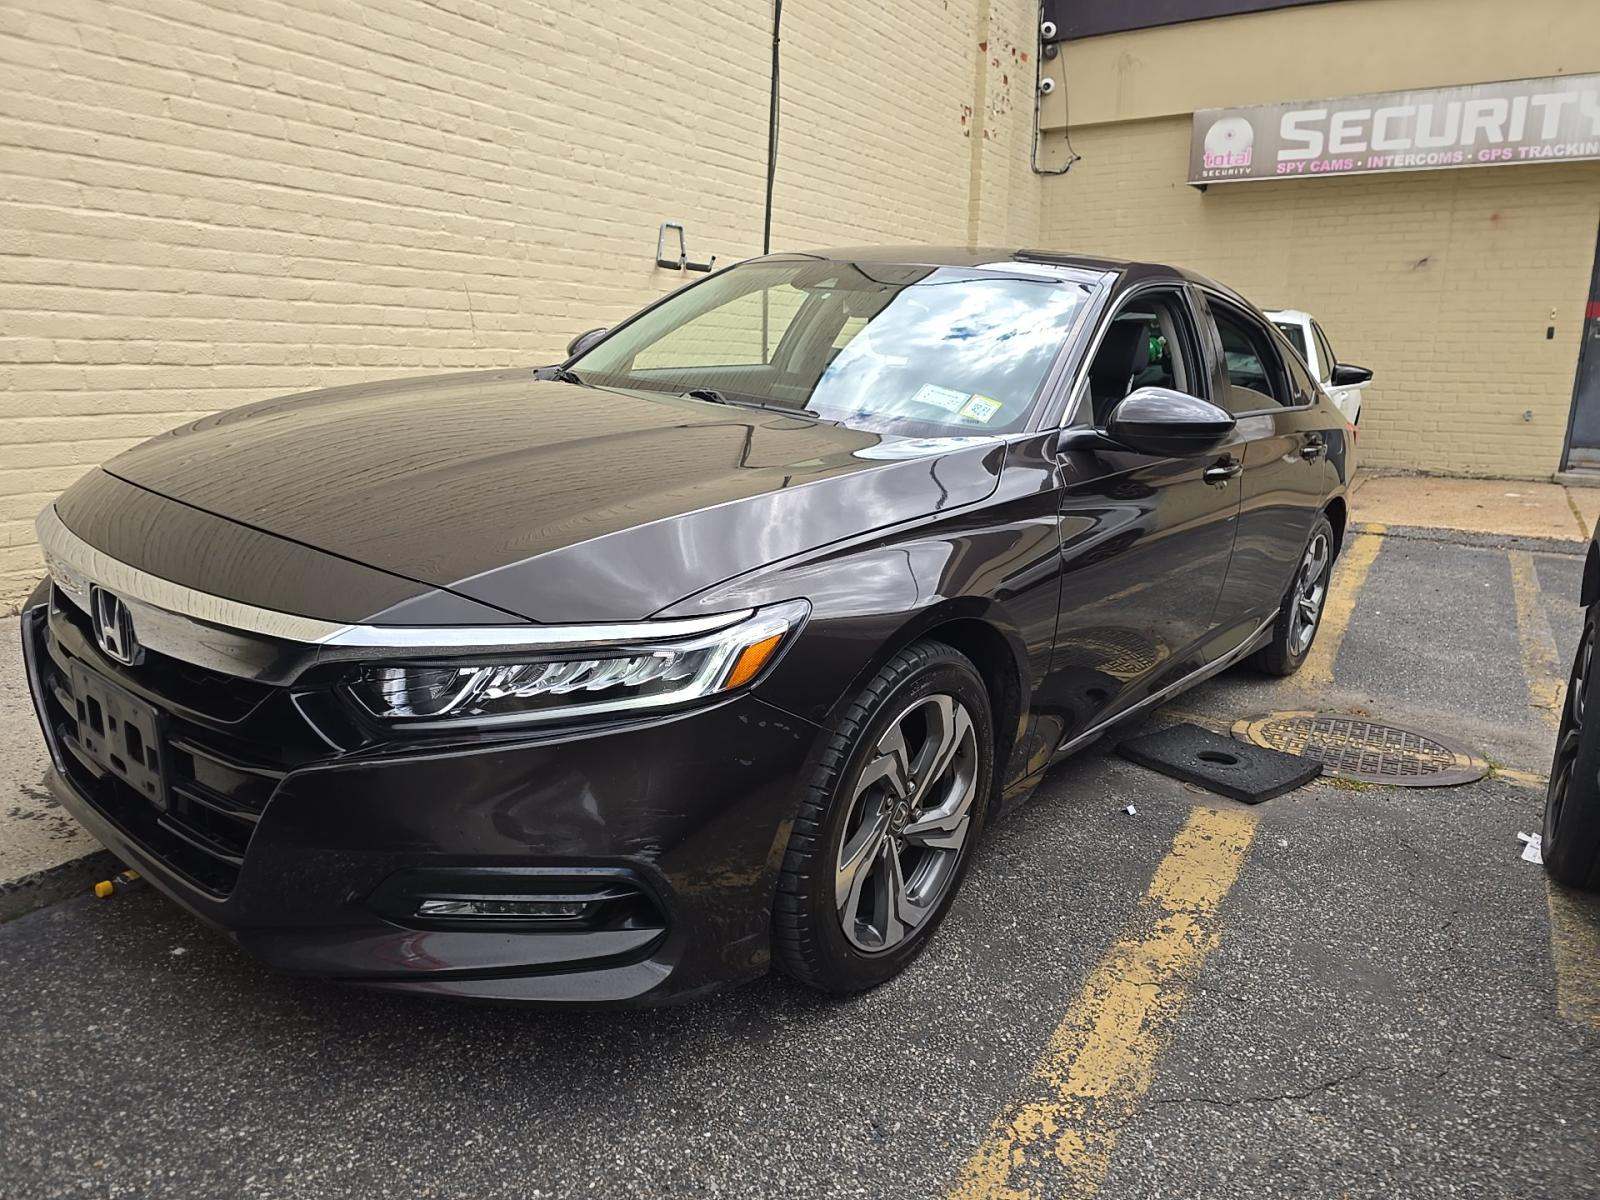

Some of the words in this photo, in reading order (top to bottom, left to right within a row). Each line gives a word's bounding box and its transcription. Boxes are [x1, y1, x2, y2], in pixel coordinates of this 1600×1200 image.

[1203, 145, 1252, 168] total
[1276, 162, 1306, 174] SPY
[1310, 159, 1353, 172] CAMS
[1367, 151, 1463, 168] INTERCOMS
[1478, 147, 1512, 161] GPS
[1518, 142, 1600, 159] TRACKIN
[1202, 167, 1251, 177] SECURITY
